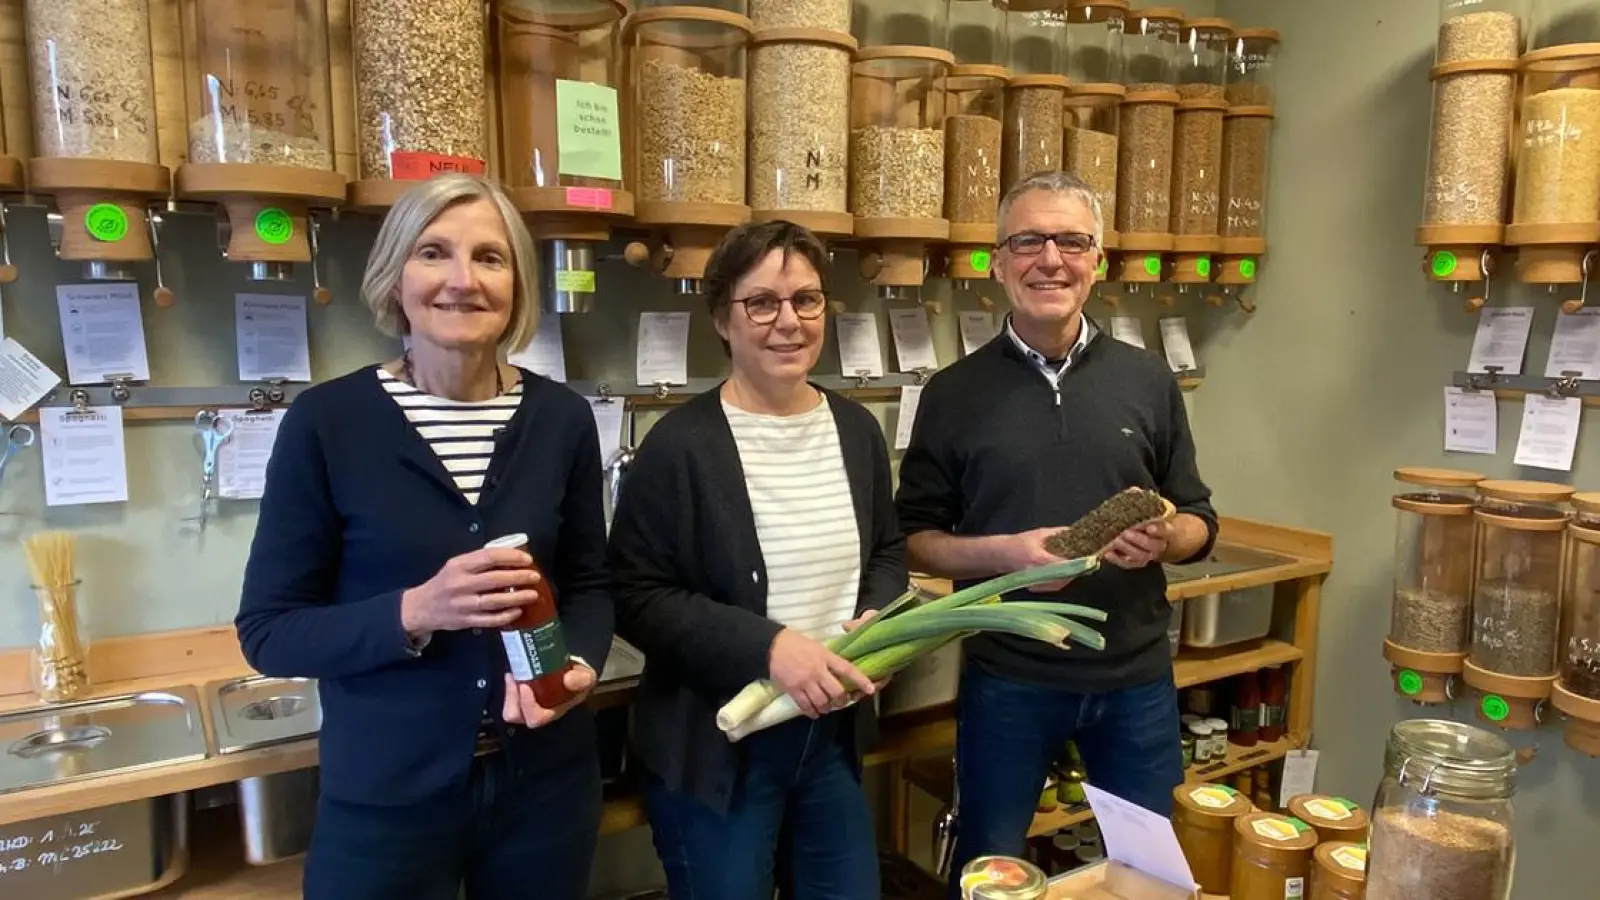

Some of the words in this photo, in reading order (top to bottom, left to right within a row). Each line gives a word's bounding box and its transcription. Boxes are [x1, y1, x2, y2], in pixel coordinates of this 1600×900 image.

[576, 100, 592, 110] Ich
[593, 102, 608, 112] bin
[579, 113, 606, 124] schon
[806, 150, 821, 168] N
[59, 414, 108, 424] Spaghetti
